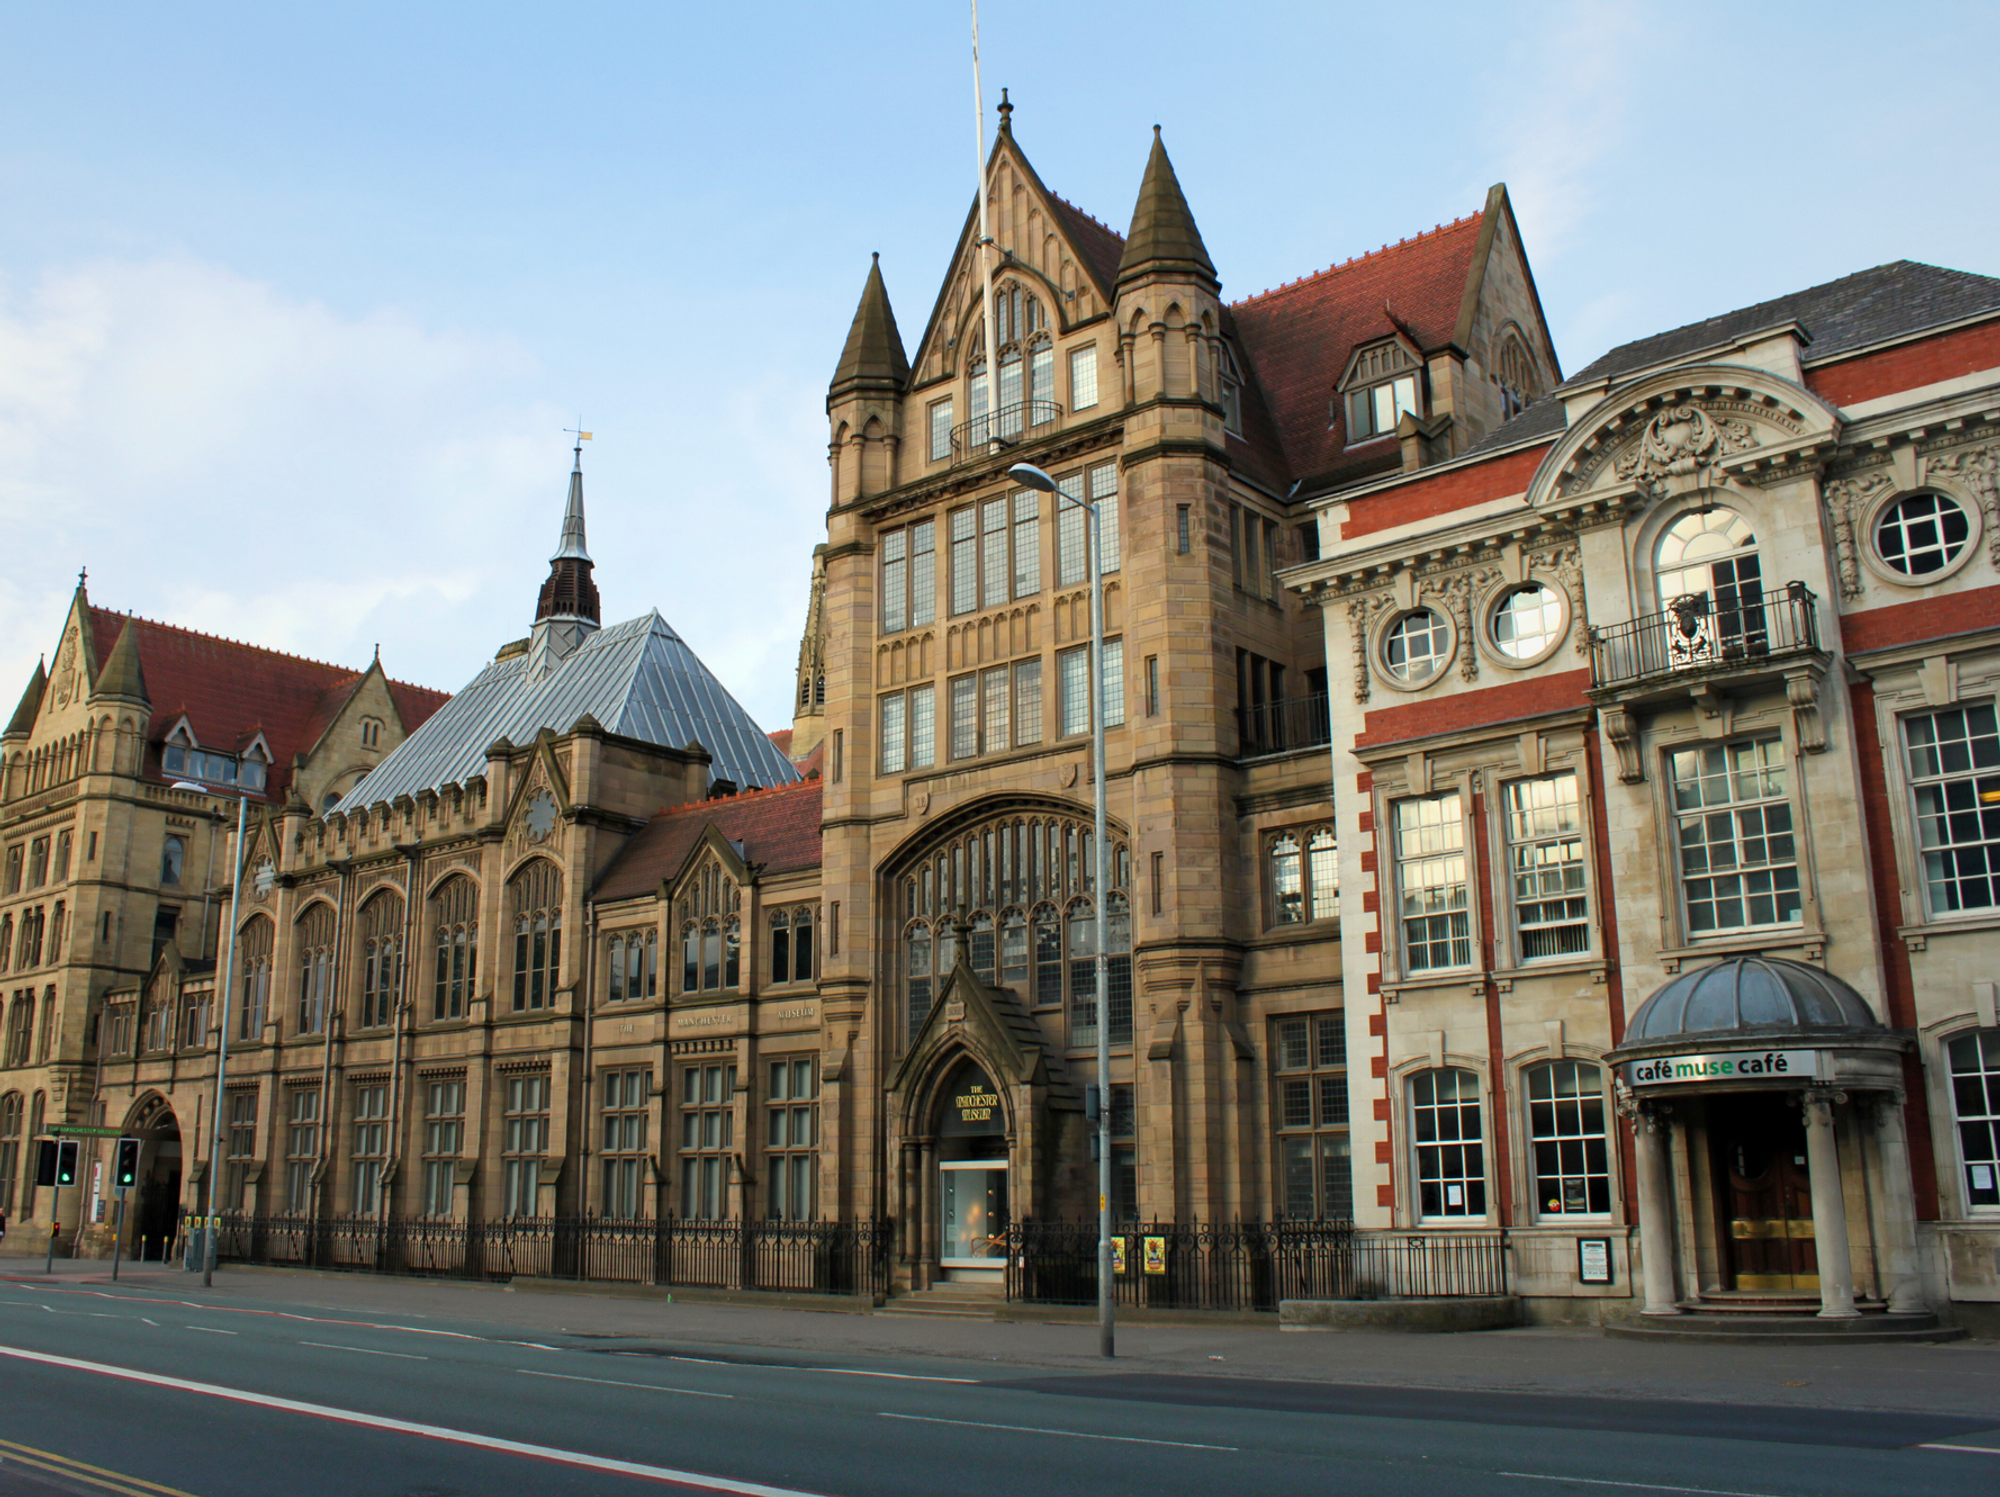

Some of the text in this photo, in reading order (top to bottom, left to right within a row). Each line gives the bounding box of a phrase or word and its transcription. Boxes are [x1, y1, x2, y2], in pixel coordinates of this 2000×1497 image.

[619, 1007, 814, 1033] THE MANCHESTER MUSEUM
[1636, 1053, 1788, 1081] café muse café
[970, 1085, 983, 1093] THE
[956, 1094, 997, 1108] MANCHESTER
[962, 1108, 991, 1121] MUSEUM
